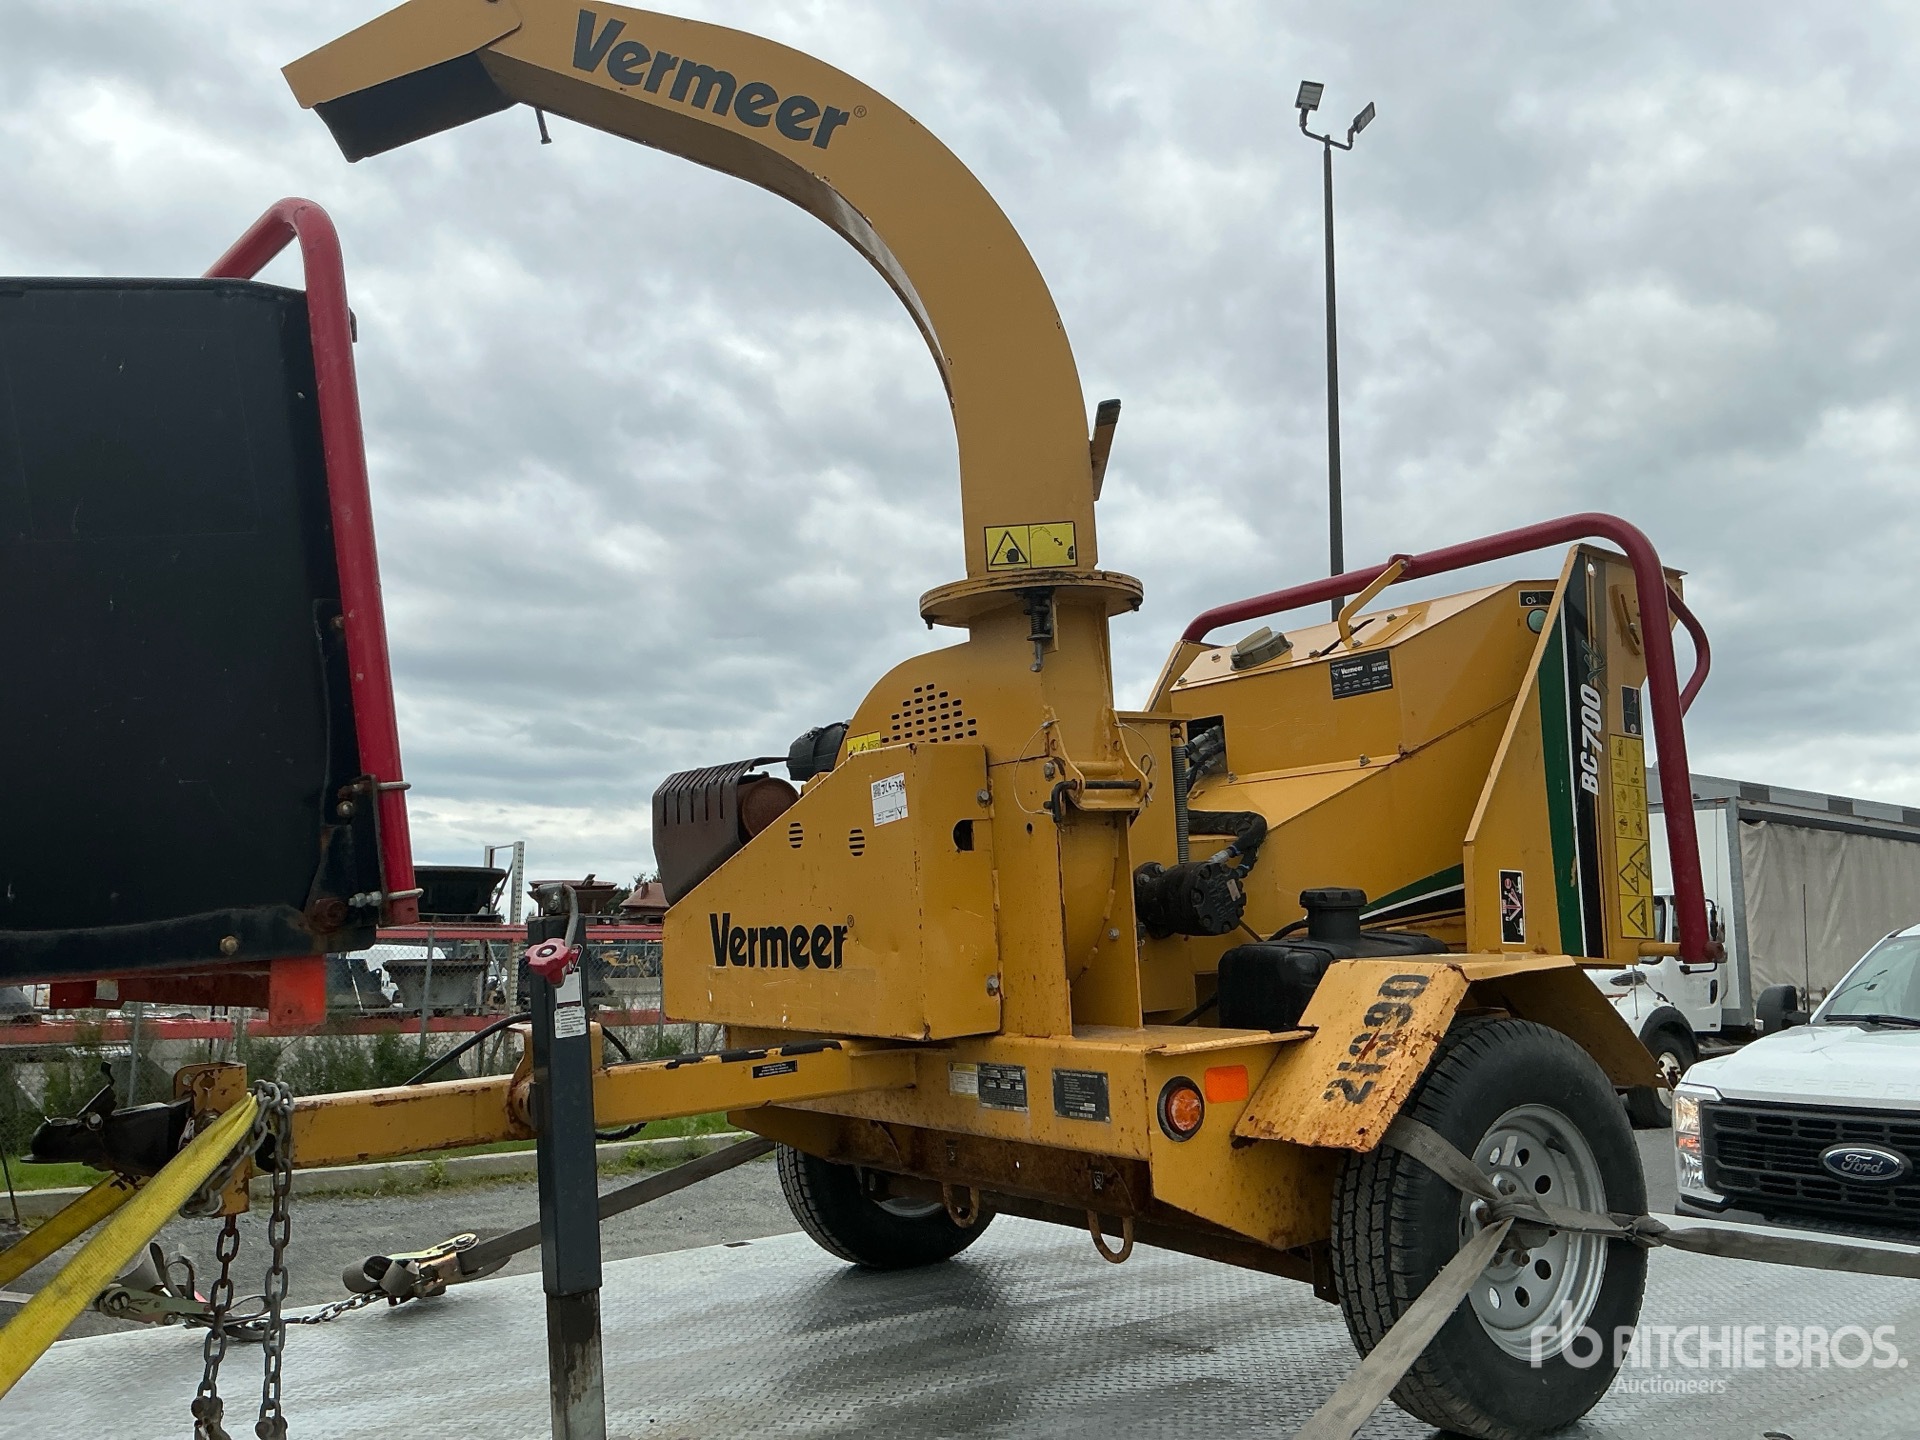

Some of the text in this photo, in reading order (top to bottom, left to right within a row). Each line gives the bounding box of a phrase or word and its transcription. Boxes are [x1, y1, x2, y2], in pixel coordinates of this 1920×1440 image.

[572, 8, 850, 150] Vermeer
[709, 912, 848, 970] Vermeer
[1840, 1154, 1884, 1175] Ford
